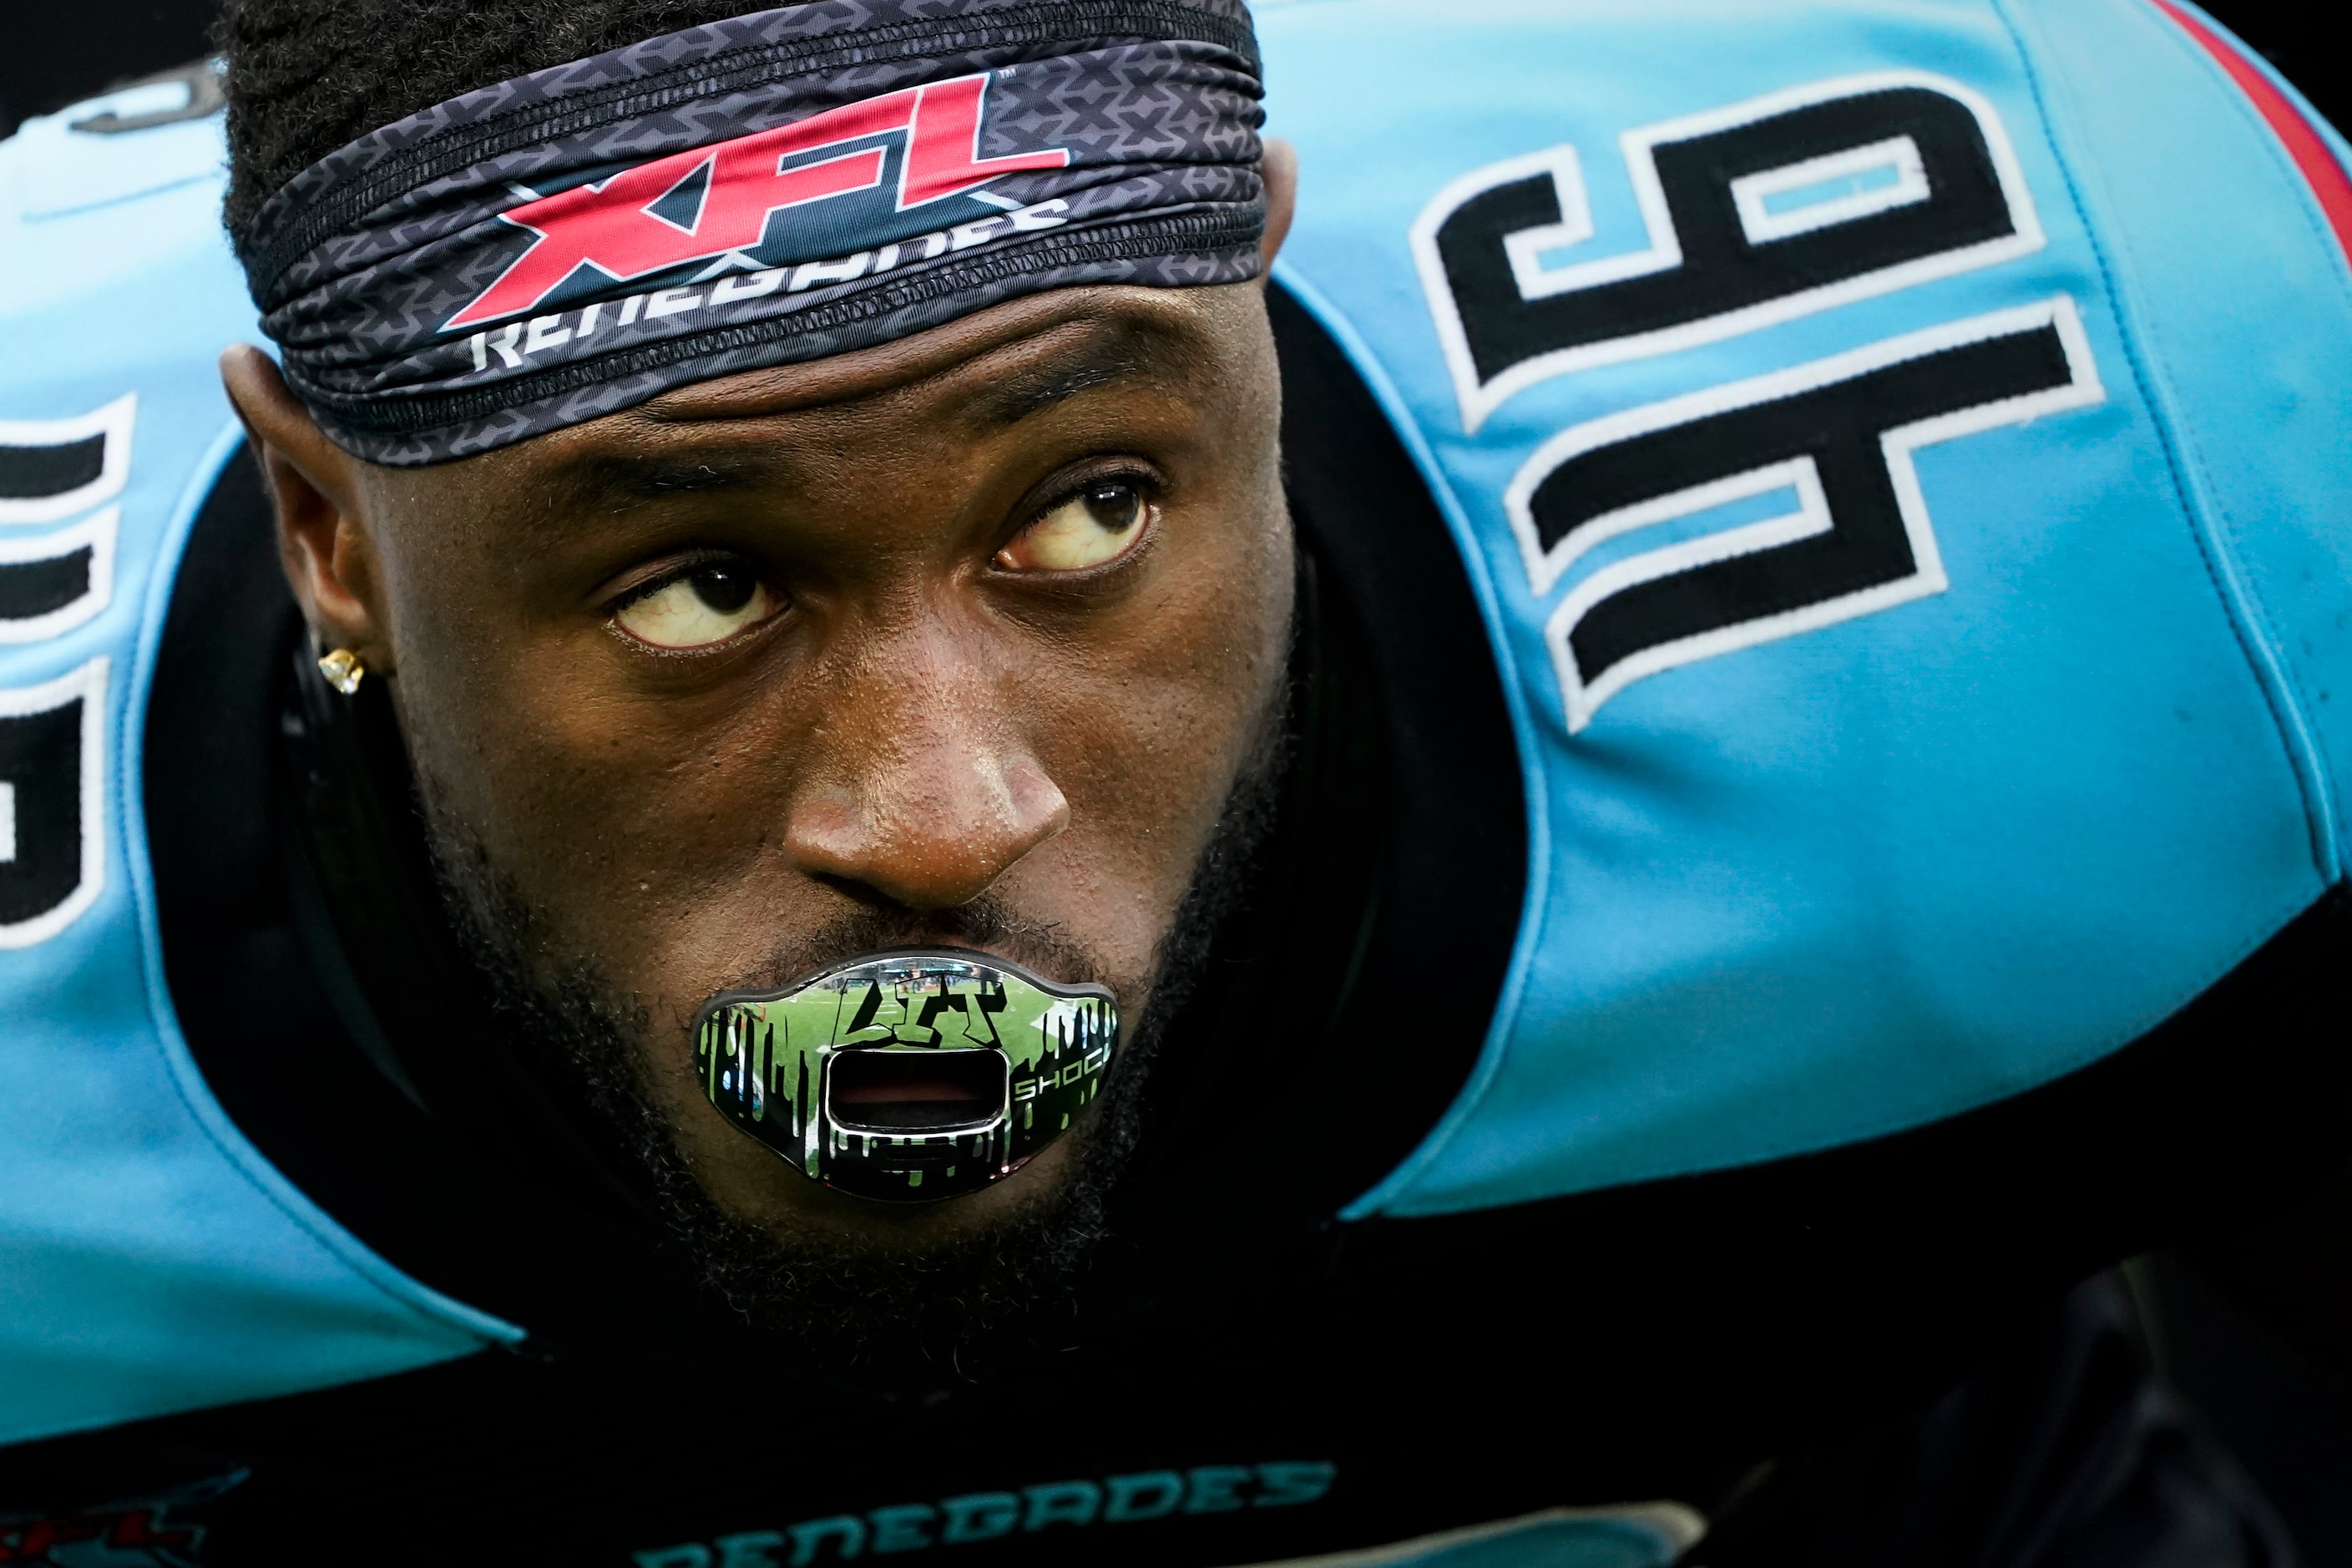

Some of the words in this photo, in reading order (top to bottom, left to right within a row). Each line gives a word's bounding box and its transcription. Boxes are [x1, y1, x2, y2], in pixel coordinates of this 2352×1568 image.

[438, 70, 1071, 332] XFL
[1409, 70, 2107, 736] 46
[831, 974, 1007, 1050] LIT
